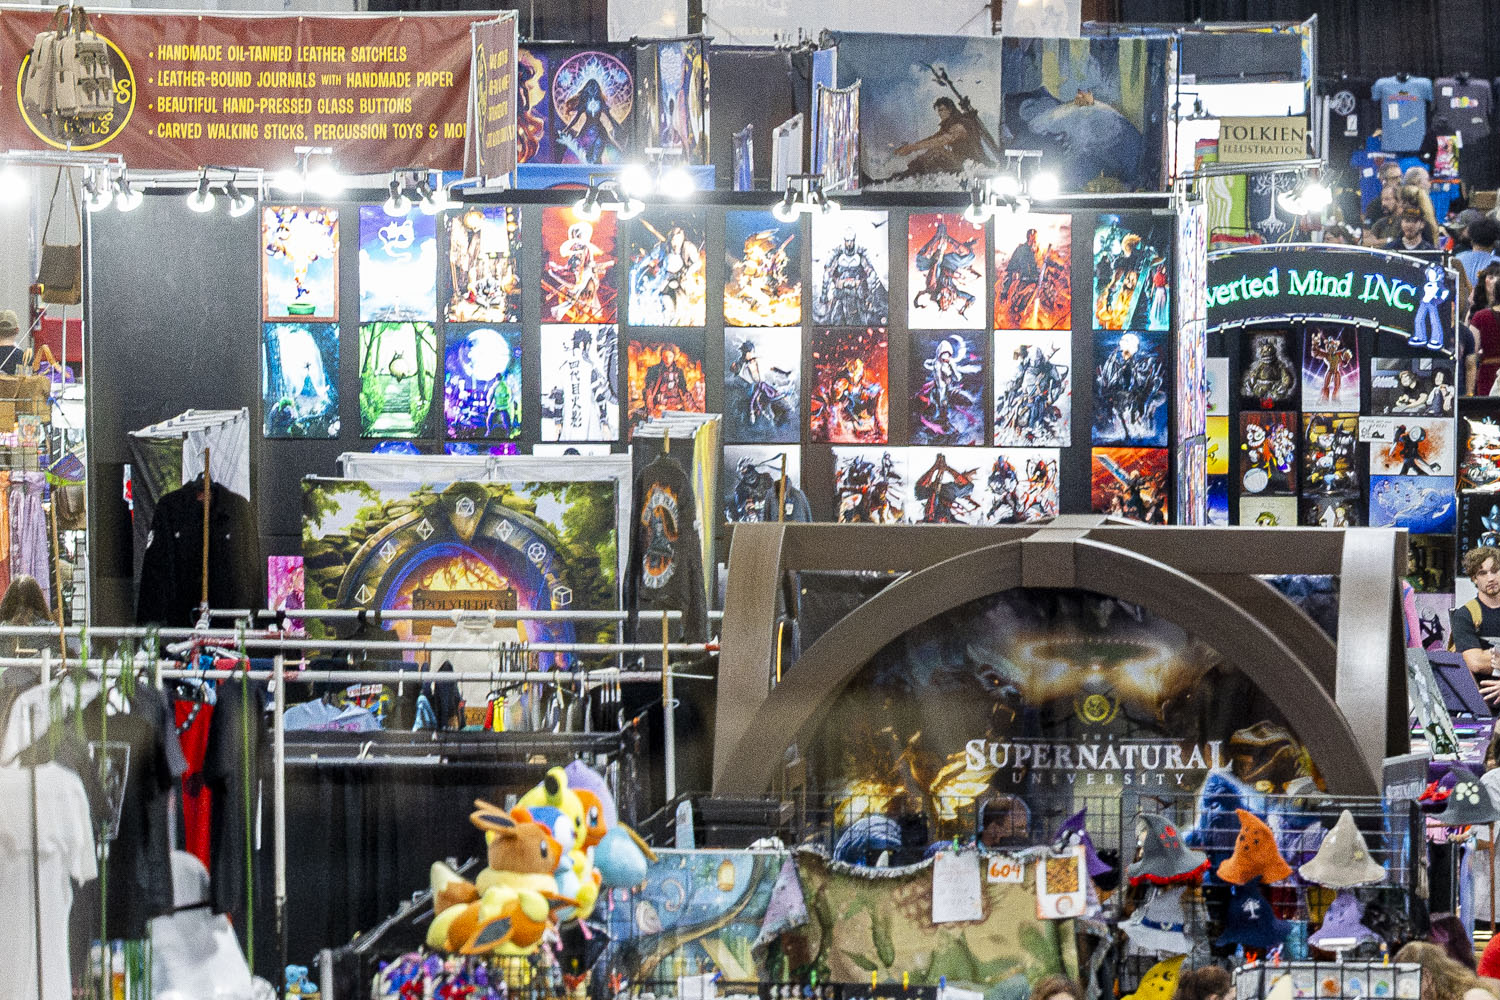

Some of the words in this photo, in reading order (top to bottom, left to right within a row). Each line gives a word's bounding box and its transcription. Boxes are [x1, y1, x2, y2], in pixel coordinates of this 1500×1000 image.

[157, 45, 222, 61] HANDMADE
[228, 45, 292, 62] OIL-TANNED
[298, 46, 345, 62] LEATHER
[351, 46, 407, 62] SATCHELS
[157, 71, 252, 87] LEATHER-BOUND
[257, 71, 316, 88] JOURNALS
[321, 74, 341, 85] WITH
[346, 72, 411, 88] HANDMADE
[417, 72, 453, 87] PAPER
[157, 96, 217, 113] BEAUTIFUL
[223, 97, 312, 113] HAND-PRESSED
[318, 98, 354, 114] GLASS
[360, 98, 412, 114] BUTTONS
[157, 123, 202, 139] CARVED
[207, 123, 258, 139] WALKING
[264, 124, 308, 141] STICKS,
[314, 123, 387, 140] PERCUSSION
[392, 123, 423, 139] TOYS
[428, 123, 438, 139] &
[1221, 126, 1304, 141] TOLKIEN
[1223, 144, 1302, 155] ILLUSTRATION
[1287, 269, 1354, 297] Mind
[1358, 273, 1417, 312] INC.
[965, 738, 1234, 772] SUPERNATURAL
[1012, 772, 1185, 785] UNIVERSITY
[989, 862, 1021, 878] 604
